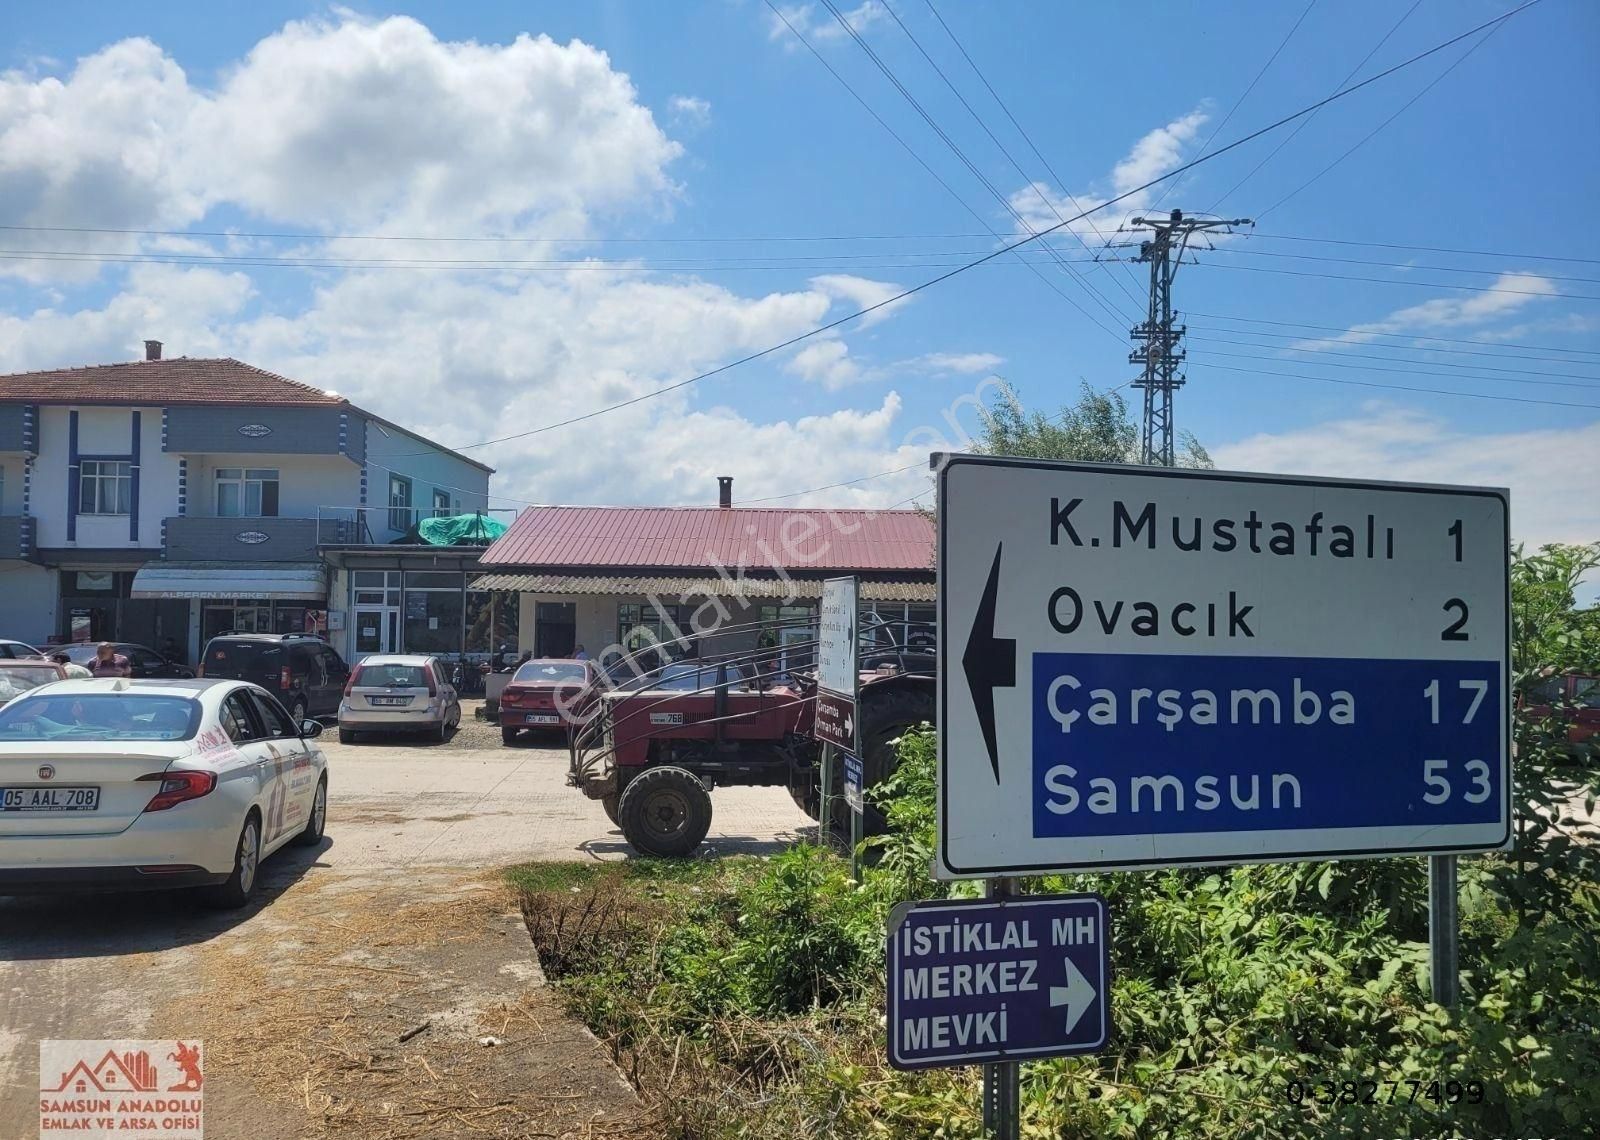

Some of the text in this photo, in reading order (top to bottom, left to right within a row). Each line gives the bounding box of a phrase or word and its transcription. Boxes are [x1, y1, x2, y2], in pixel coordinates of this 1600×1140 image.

[1050, 497, 1464, 562] K.Mustafalı 1
[160, 591, 216, 599] ALPEREN
[220, 592, 271, 600] MARKET
[1047, 586, 1469, 641] Ovacık 2
[667, 713, 682, 723] 768
[1046, 674, 1488, 733] Çarşamba 17
[832, 722, 843, 738] Park
[4, 790, 95, 806] 05 AAL 708
[1044, 759, 1492, 814] Samsun 53
[904, 916, 1095, 956] İSTİKLAL MH
[904, 960, 1039, 1000] MERKEZ
[904, 1003, 1008, 1051] MEVKİ
